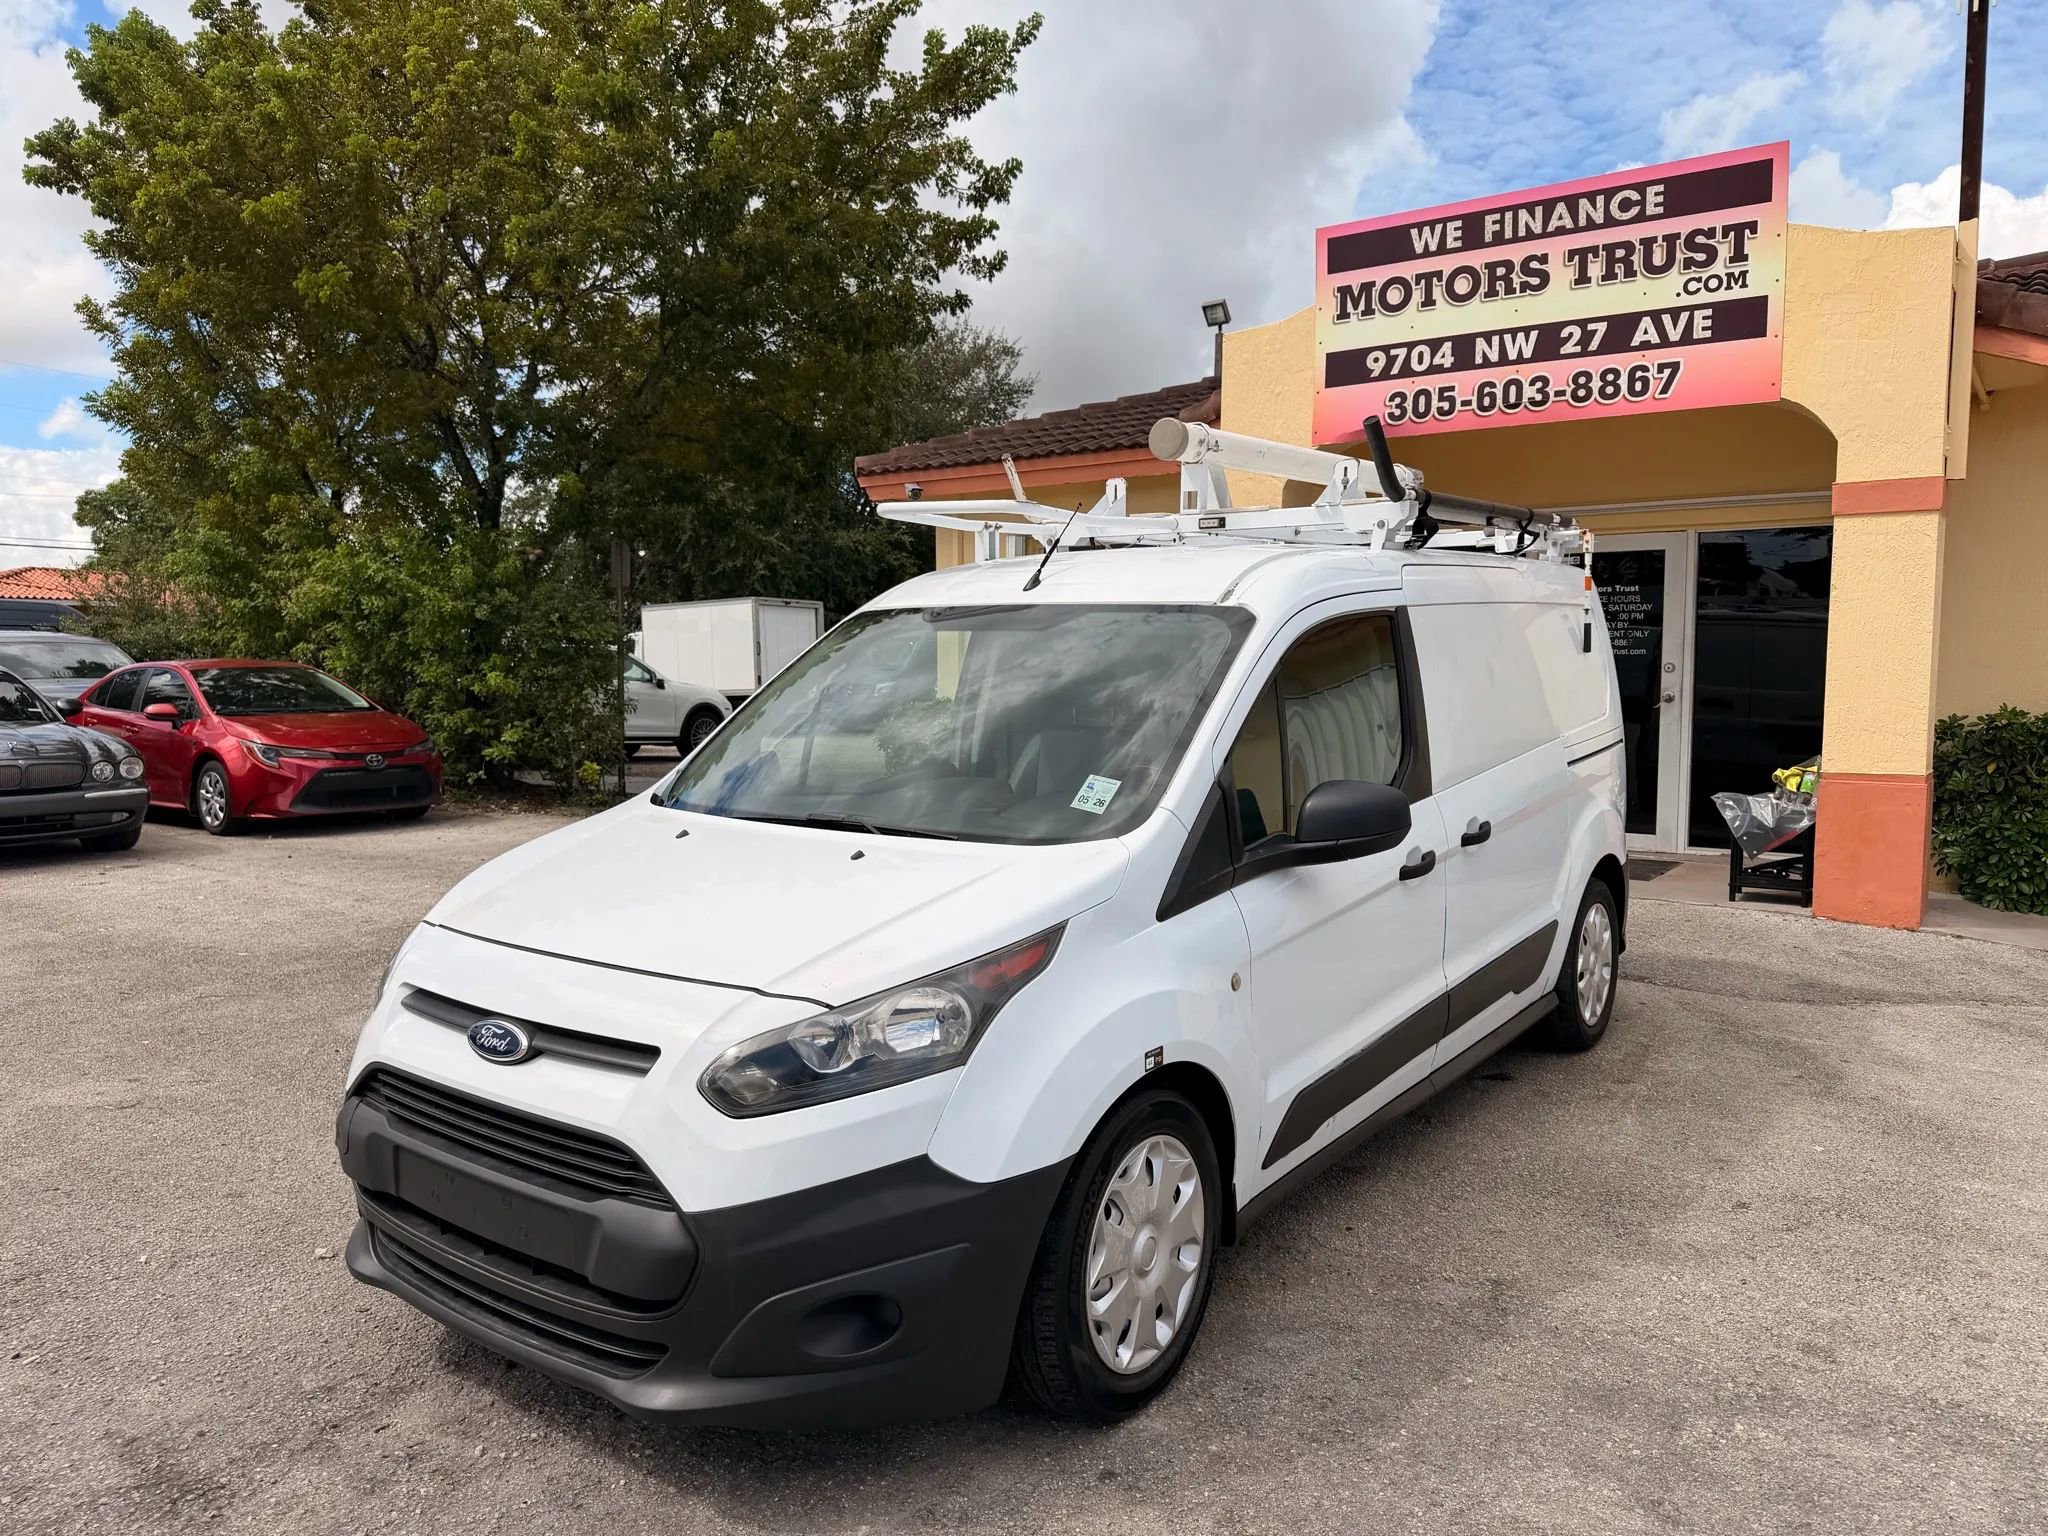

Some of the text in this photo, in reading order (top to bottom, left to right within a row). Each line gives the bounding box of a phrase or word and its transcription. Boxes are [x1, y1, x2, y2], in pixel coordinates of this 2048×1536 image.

[1410, 184, 1665, 254] WE FINANCE
[1335, 219, 1759, 322] MOTORS TRUST
[1675, 269, 1749, 297] .COM
[1366, 308, 1713, 378] 9704 NW 27 AVE
[1385, 359, 1683, 424] 305-603-8867
[1610, 594, 1641, 602] HOURS
[1614, 584, 1640, 592] Trust
[1608, 603, 1653, 611] SATURDAY
[1630, 612, 1644, 620] PM
[1078, 794, 1107, 808] 05 26
[475, 1025, 511, 1052] Ford
